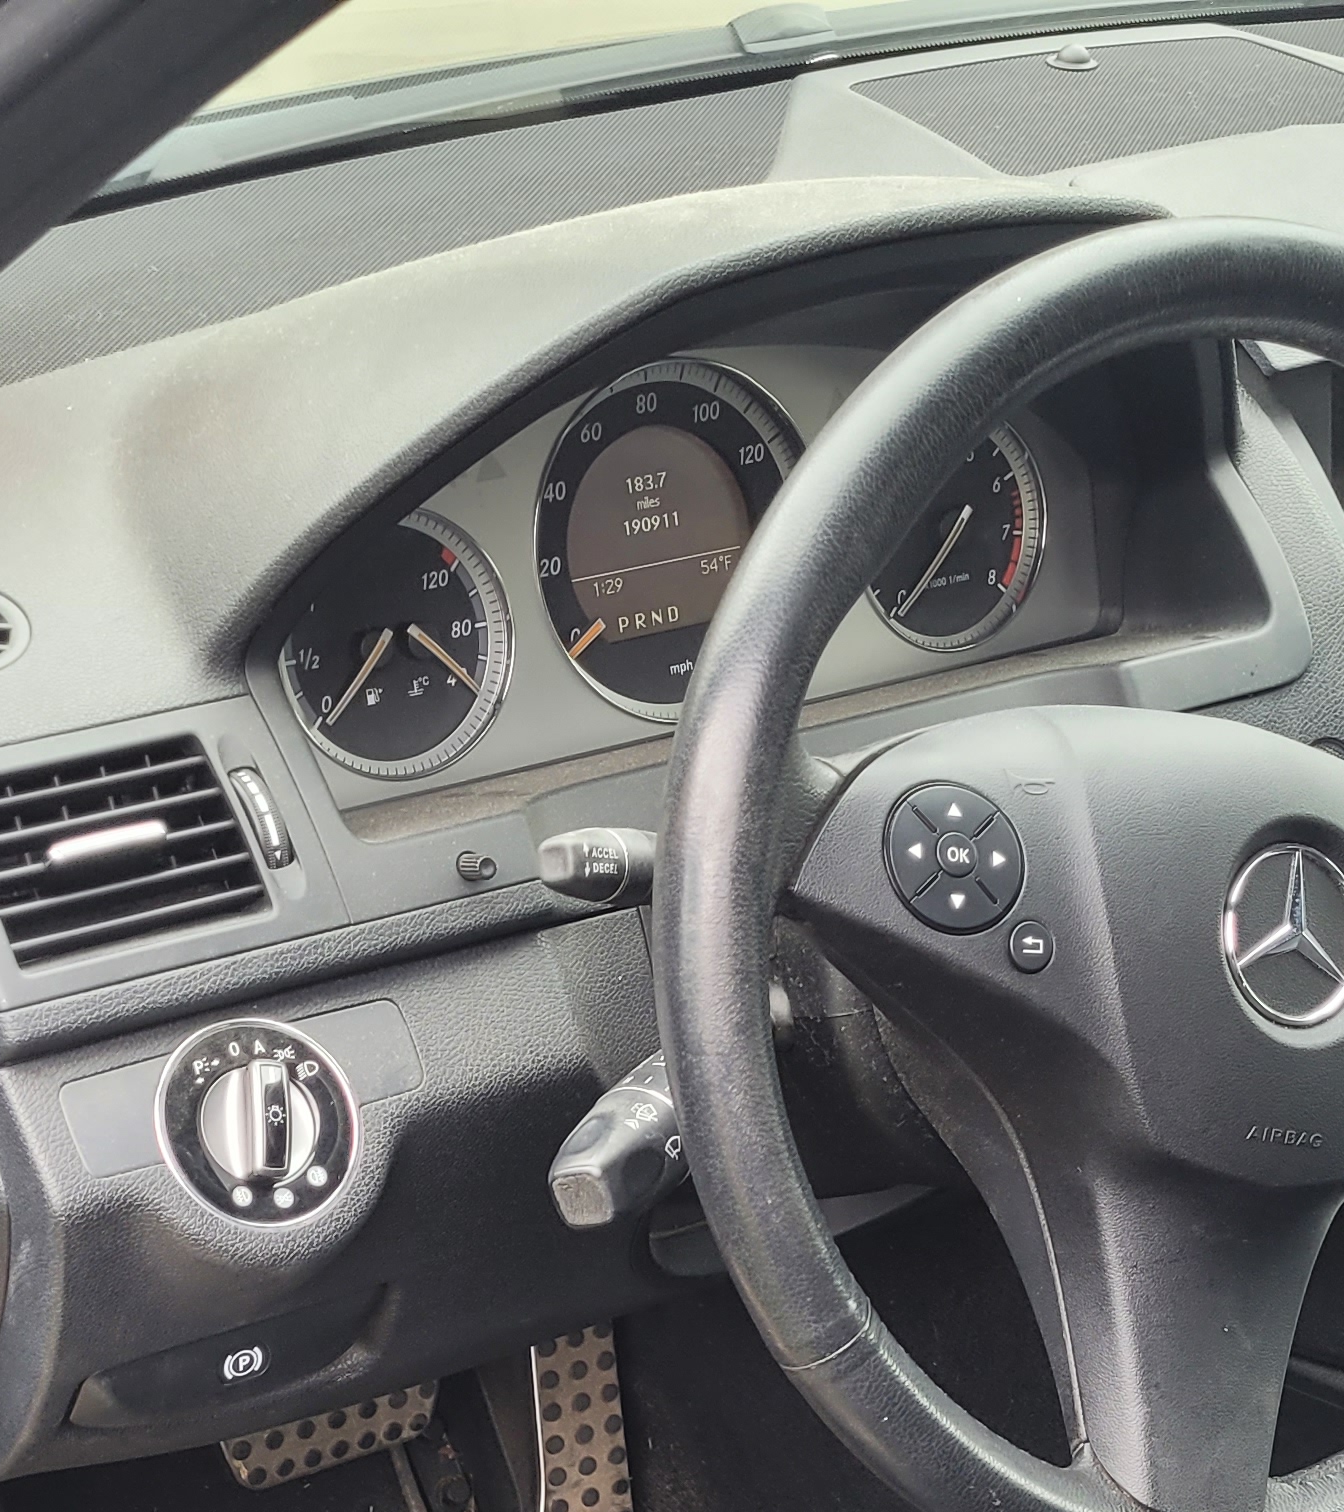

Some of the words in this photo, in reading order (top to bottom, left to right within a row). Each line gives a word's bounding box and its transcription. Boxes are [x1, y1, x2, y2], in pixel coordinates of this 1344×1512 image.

[636, 392, 657, 414] 80
[692, 401, 720, 423] 100
[581, 422, 602, 442] 60
[739, 443, 764, 465] 120
[544, 481, 566, 503] 40
[625, 471, 667, 494] 183.7
[993, 476, 1001, 493] 6
[636, 496, 660, 511] miles
[623, 511, 679, 536] 190911
[1002, 524, 1011, 541] 7
[540, 556, 561, 577] 20
[593, 577, 623, 598] 1:29
[700, 555, 732, 575] 54°F
[421, 569, 449, 590] 120
[987, 569, 997, 586] 8
[451, 619, 472, 638] 80
[299, 648, 320, 670] 1/2
[669, 659, 694, 676] mph
[322, 696, 332, 713] 0
[592, 848, 619, 859] ACCEL
[947, 847, 970, 864] OK
[593, 862, 618, 875] DECEL
[193, 1060, 203, 1075] P
[254, 1039, 266, 1055] A
[1245, 1125, 1323, 1147] AIRBAG
[239, 1355, 251, 1372] P
